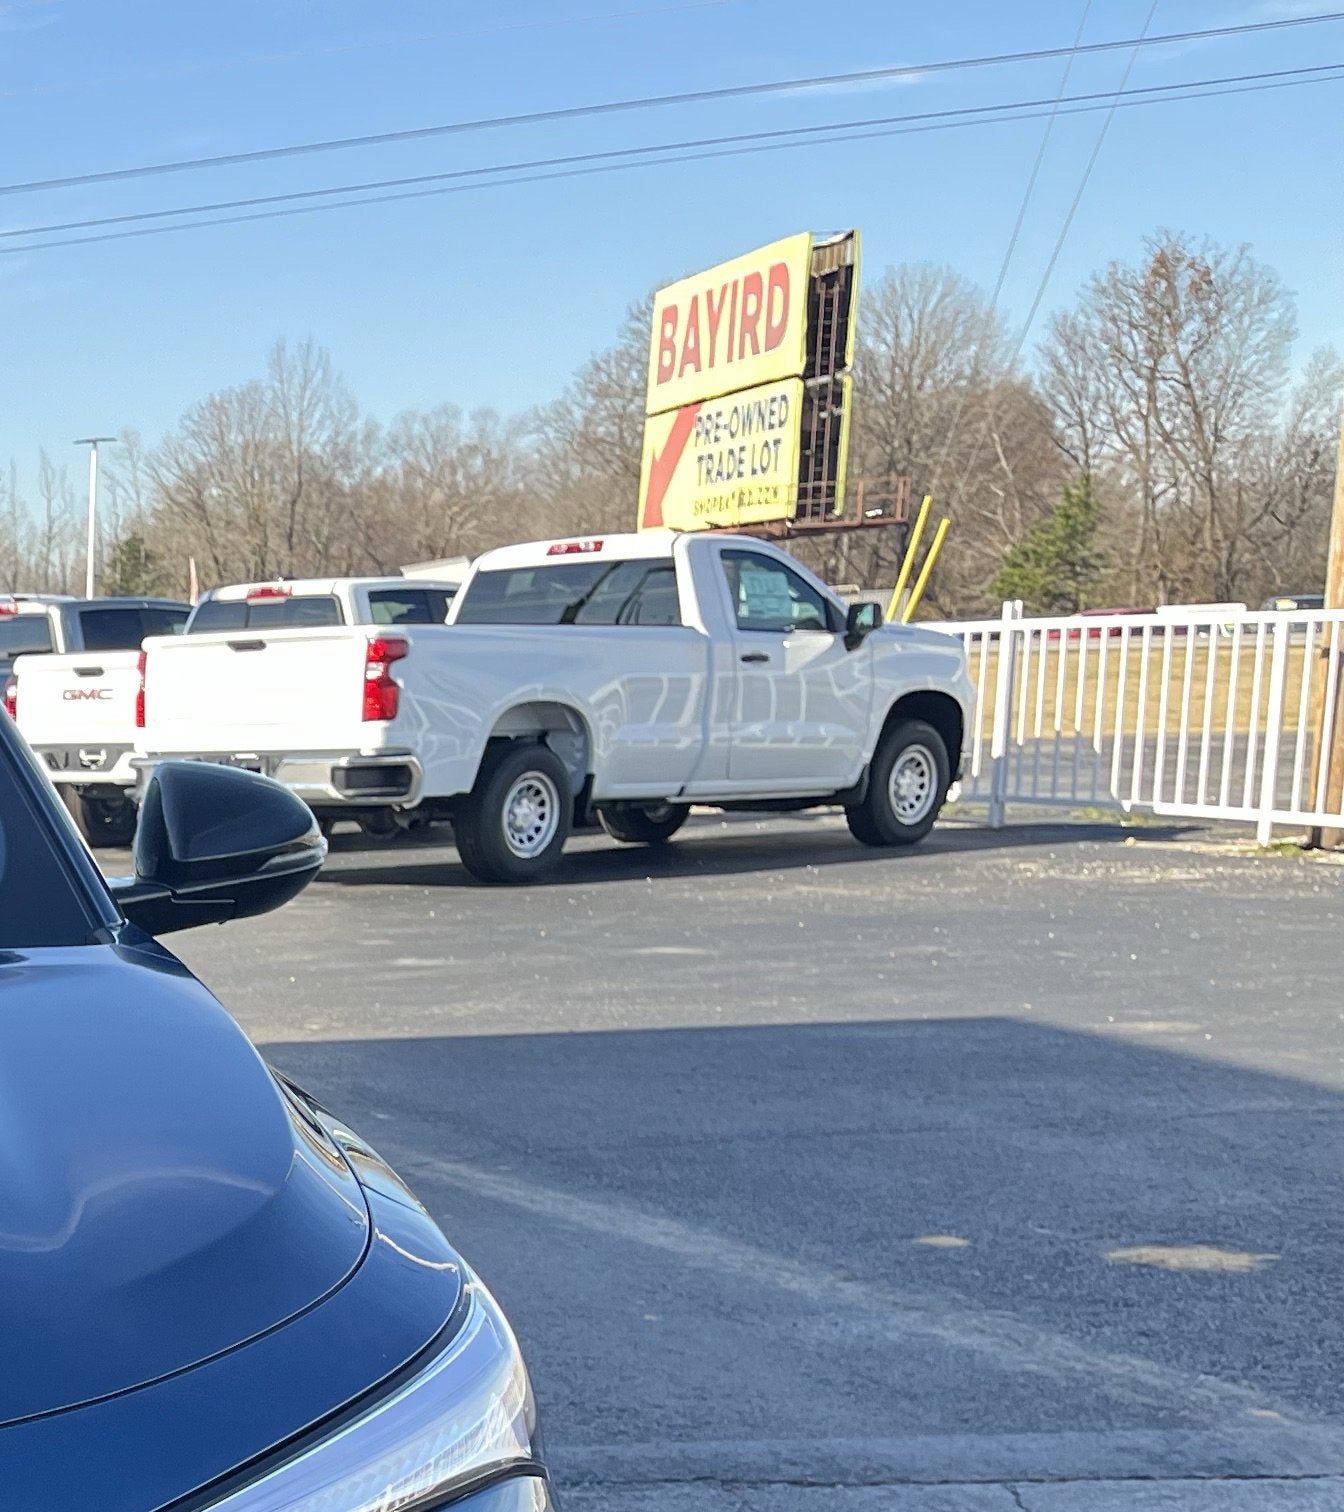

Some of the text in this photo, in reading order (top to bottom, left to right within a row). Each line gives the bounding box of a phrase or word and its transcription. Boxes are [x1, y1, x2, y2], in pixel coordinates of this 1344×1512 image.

[656, 262, 790, 385] BAYIRD
[694, 394, 789, 447] PRE-OWNED
[697, 438, 782, 486] TRADE LOT
[62, 688, 114, 701] GMC
